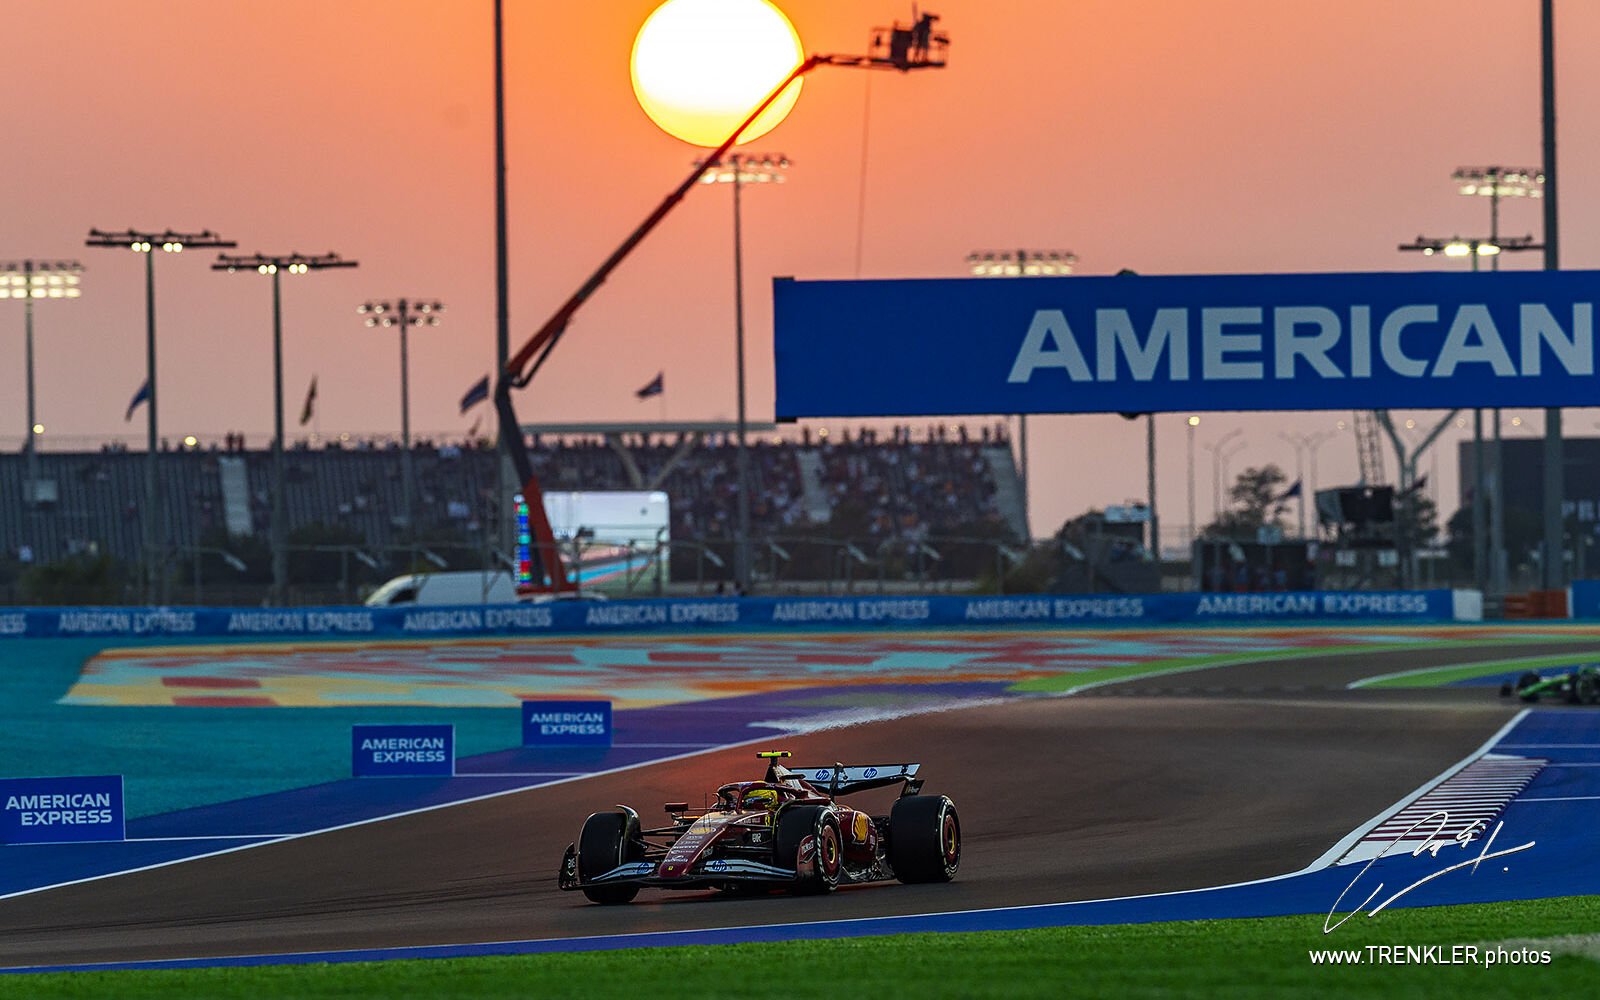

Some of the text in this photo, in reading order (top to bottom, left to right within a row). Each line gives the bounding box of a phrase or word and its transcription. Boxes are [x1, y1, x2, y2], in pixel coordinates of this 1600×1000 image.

[1007, 302, 1594, 384] AMERICAN
[586, 603, 739, 625] AMERICAN EXPRESS
[772, 600, 930, 621] AMERICAN EXPRESS
[965, 599, 1144, 620] AMERICAN EXPRESS
[1197, 595, 1427, 614] AMERICAN EXPRESS
[58, 612, 129, 632] AMERICAN
[228, 612, 374, 632] AMERICAN EXPRESS
[403, 608, 552, 630] AMERICAN EXPRESS
[531, 713, 603, 723] AMERICAN
[541, 724, 605, 735] EXPRESS
[361, 738, 444, 750] AMERICAN
[373, 751, 446, 763] EXPRESS
[5, 793, 110, 810] AMERICAN
[21, 809, 113, 826] EXPRESS
